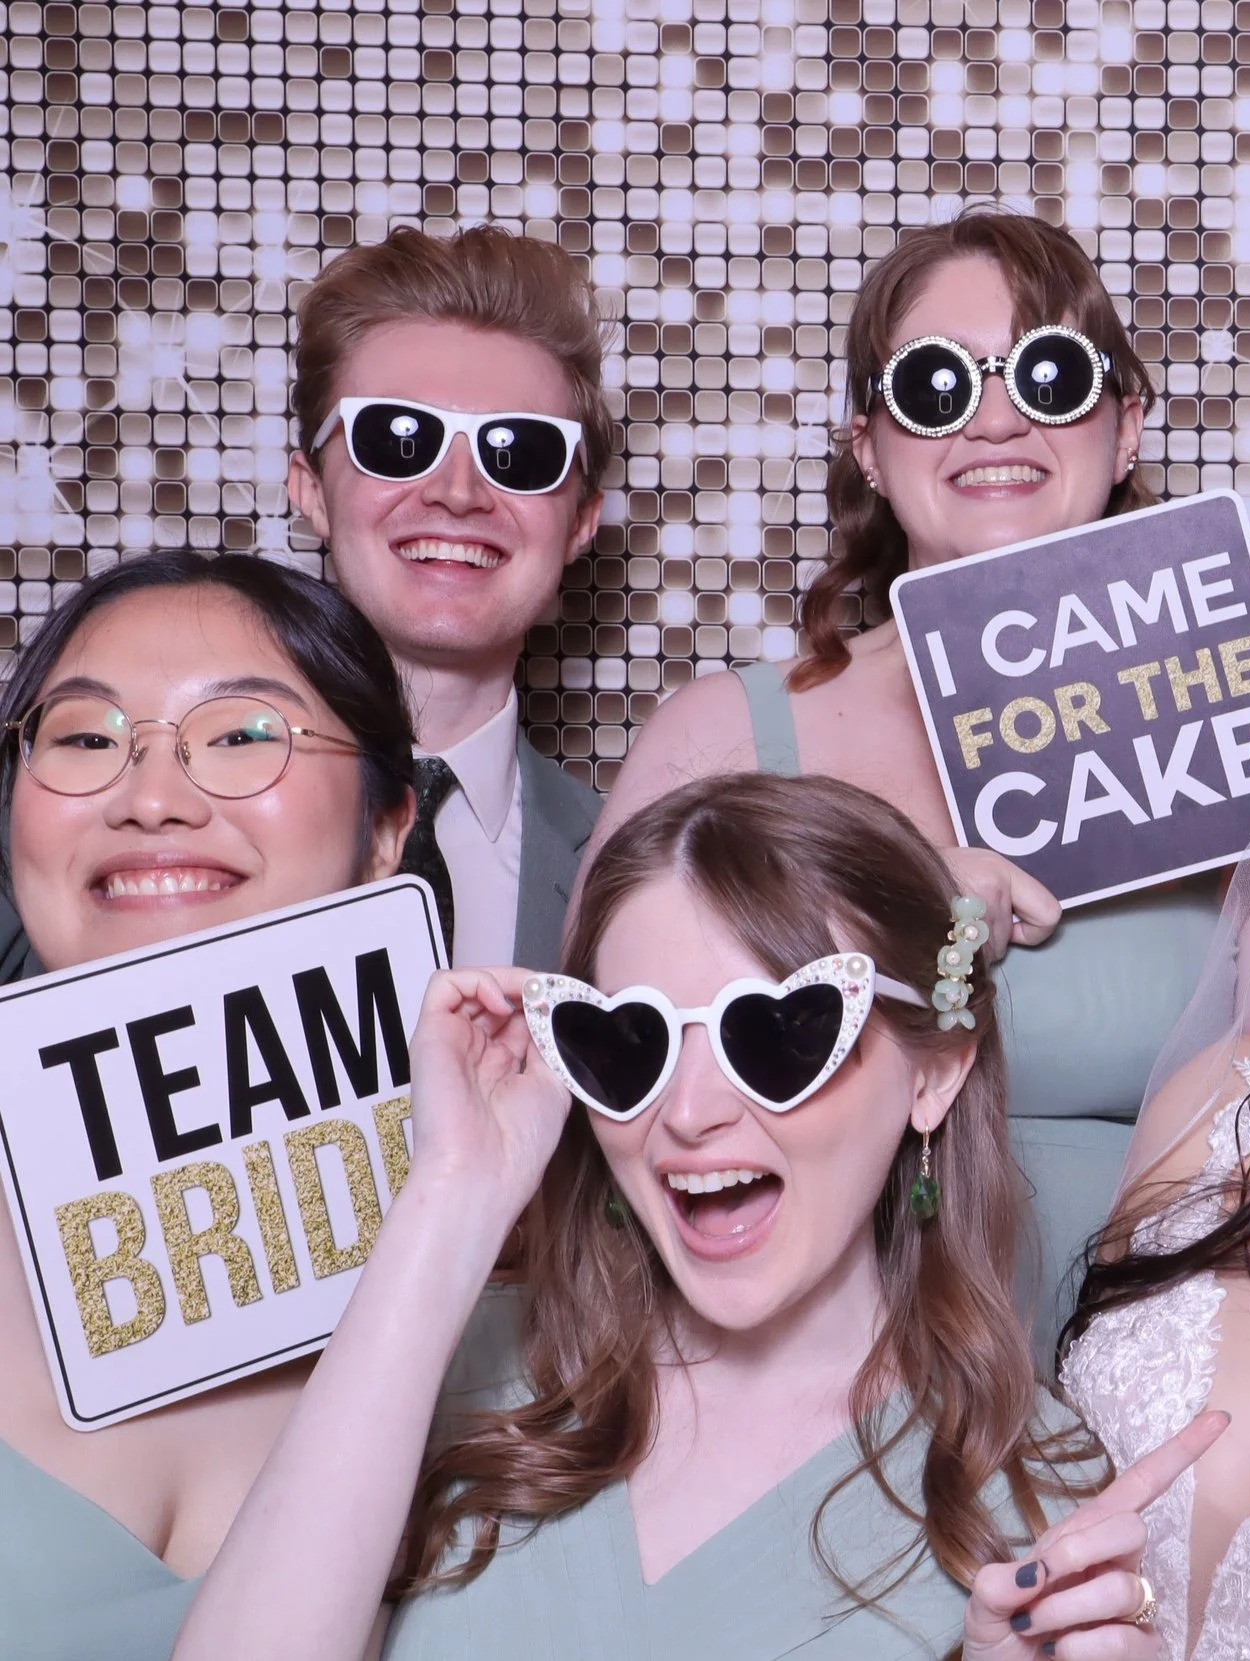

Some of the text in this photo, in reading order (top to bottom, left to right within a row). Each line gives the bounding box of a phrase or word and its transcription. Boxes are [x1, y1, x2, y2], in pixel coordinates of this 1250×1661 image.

[925, 551, 1248, 698] I CAME
[952, 681, 1112, 771] FOR
[38, 947, 412, 1182] TEAM
